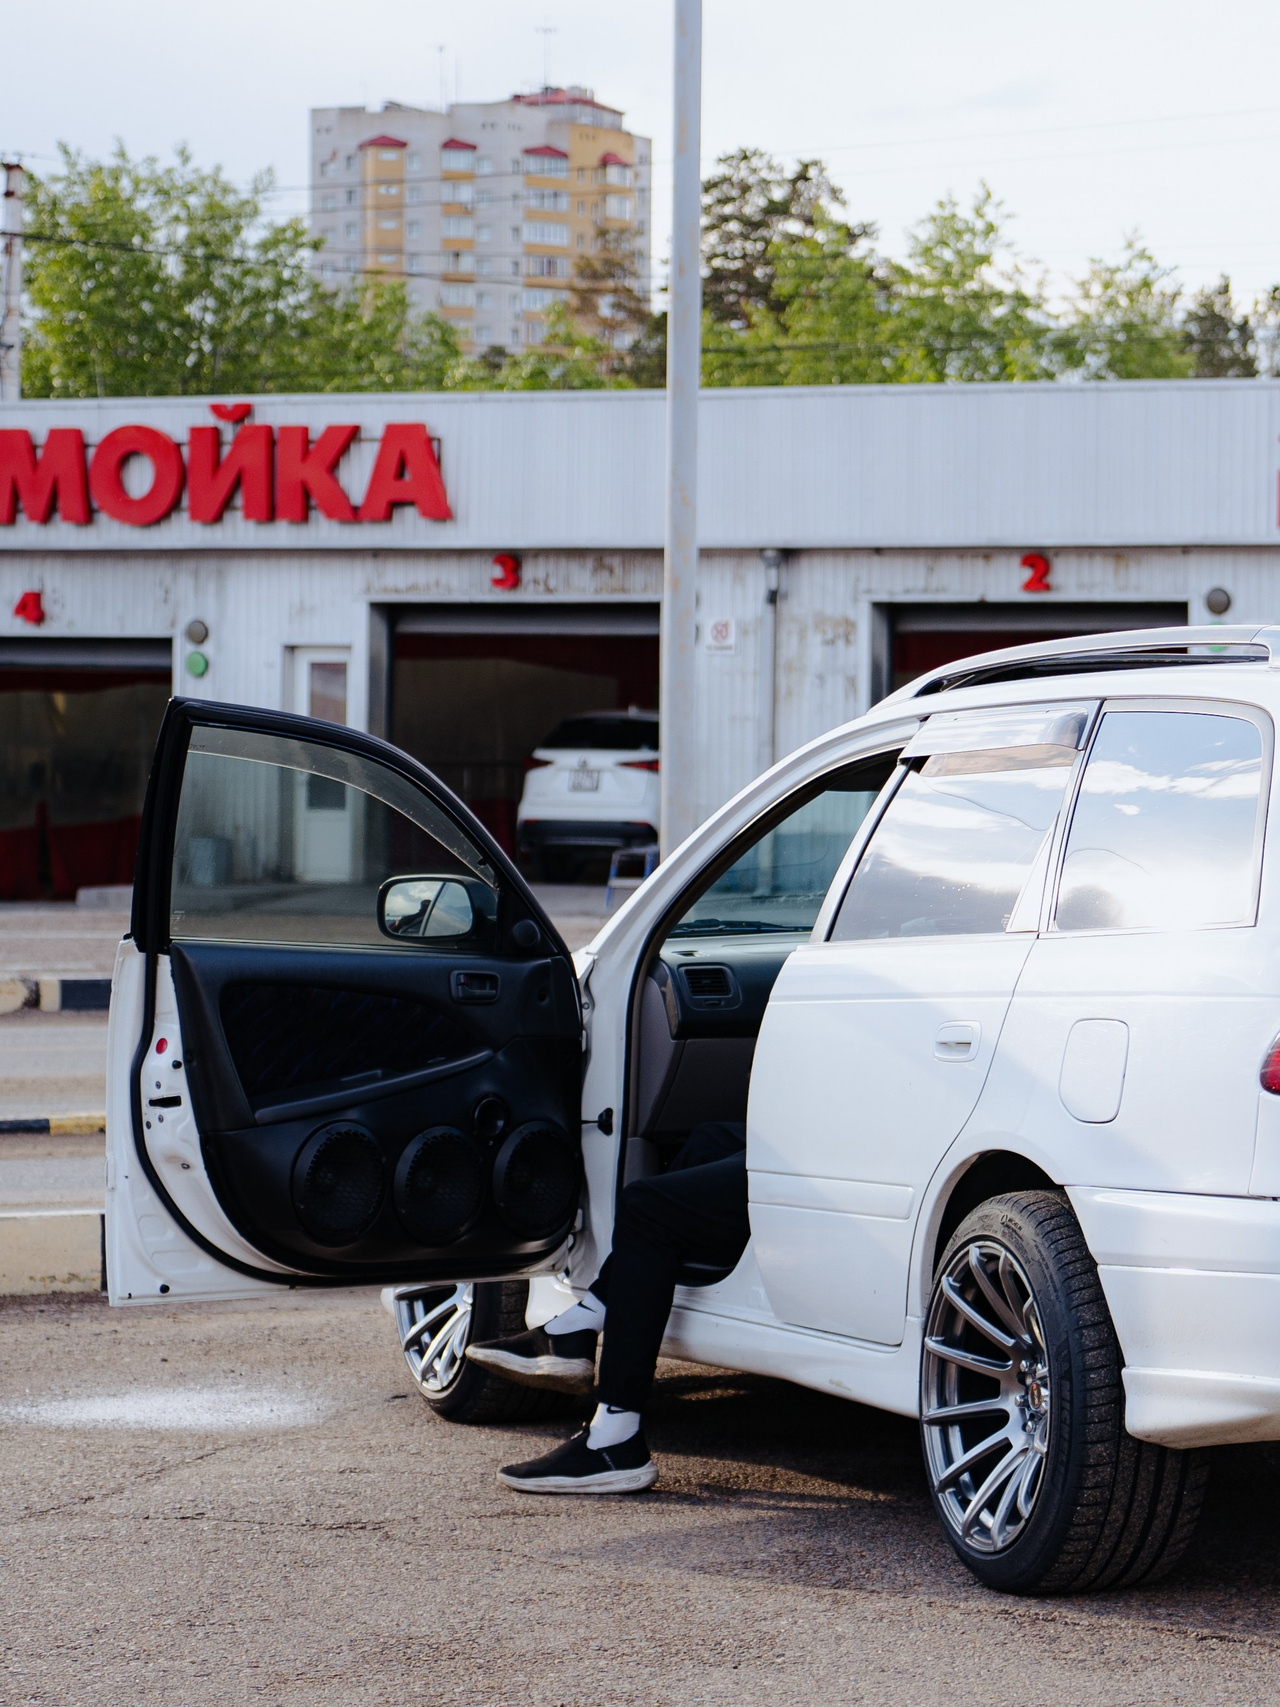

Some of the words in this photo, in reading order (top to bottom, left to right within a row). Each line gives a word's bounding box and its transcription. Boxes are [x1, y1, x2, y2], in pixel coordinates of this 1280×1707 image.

[0, 403, 453, 526] МОЙКА
[490, 554, 520, 591] 3
[1020, 553, 1051, 592] 2
[14, 591, 45, 625] 4
